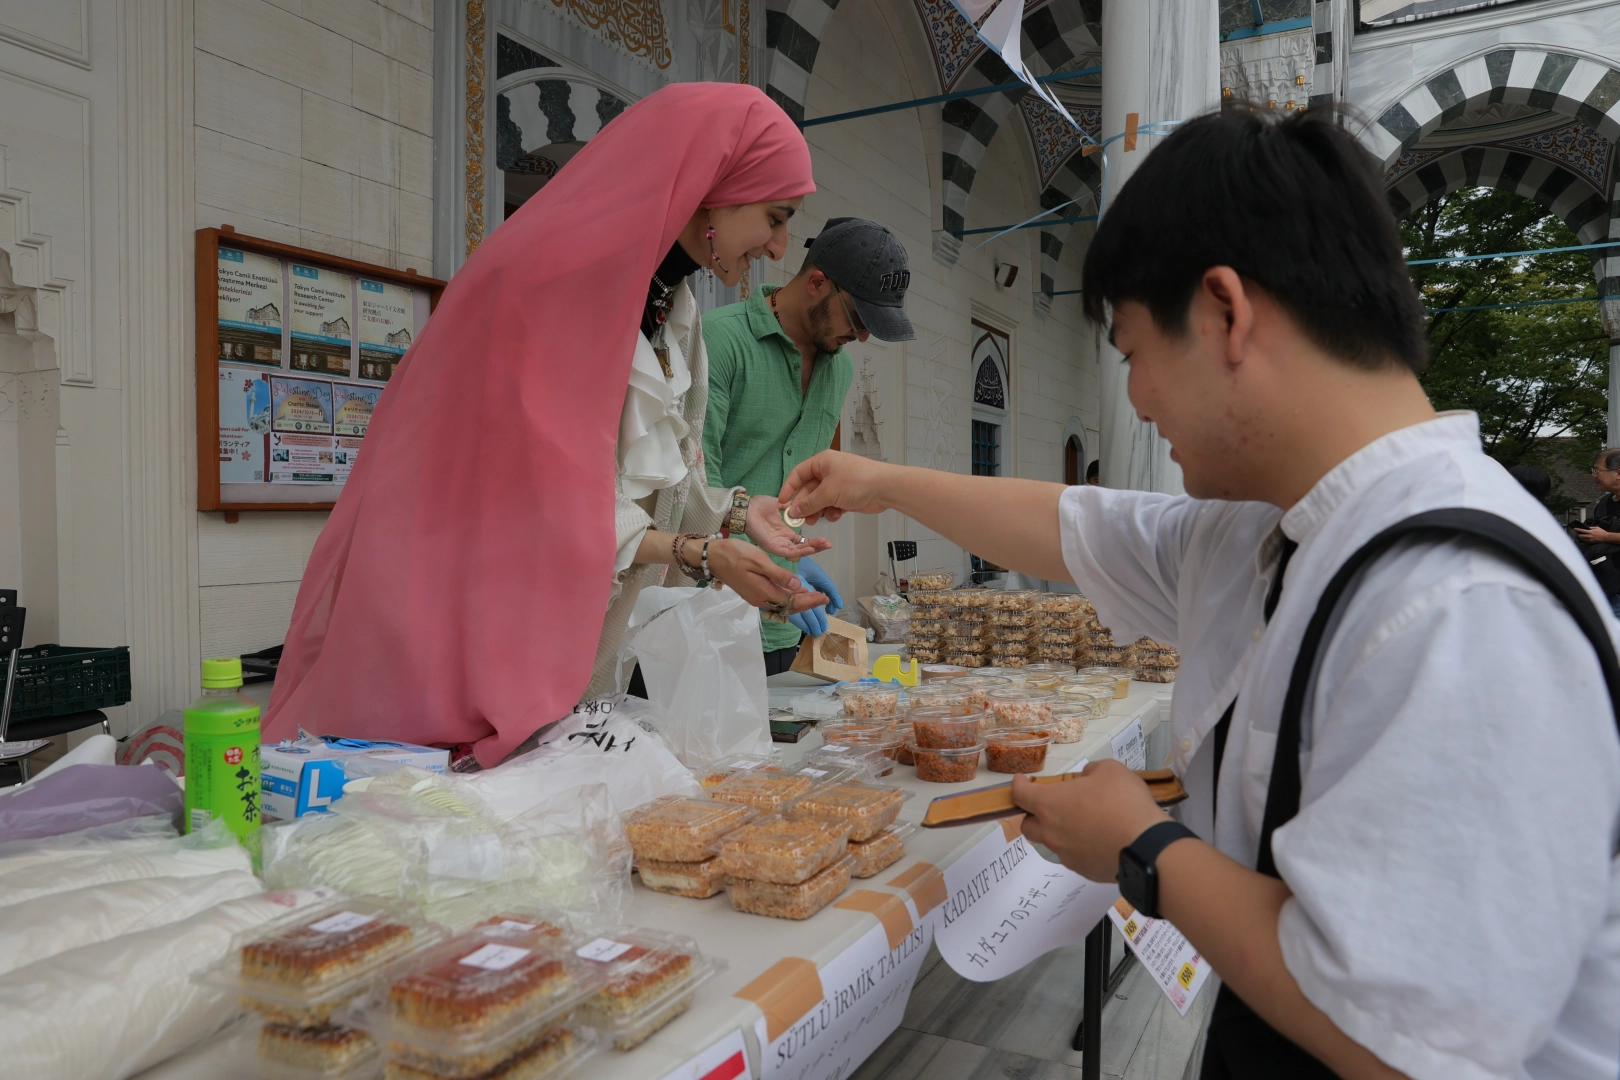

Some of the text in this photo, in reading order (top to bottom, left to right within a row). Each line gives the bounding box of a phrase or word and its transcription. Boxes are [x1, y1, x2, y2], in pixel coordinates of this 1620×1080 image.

[218, 285, 253, 296] esteklerinizi
[245, 281, 268, 290] Merkezi
[294, 283, 310, 292] Tokyo
[325, 290, 346, 299] Institute
[294, 291, 335, 304] Research Center
[273, 382, 331, 402] Palestine Day
[334, 388, 365, 403] Palestine
[235, 765, 261, 822] お茶
[307, 768, 332, 808] L
[942, 868, 990, 929] KADAYIF
[989, 837, 1028, 883] TATLISI
[776, 1000, 831, 1070] SÜTLÜ
[834, 965, 875, 1019] İRMİK
[877, 924, 925, 980] TATLISI
